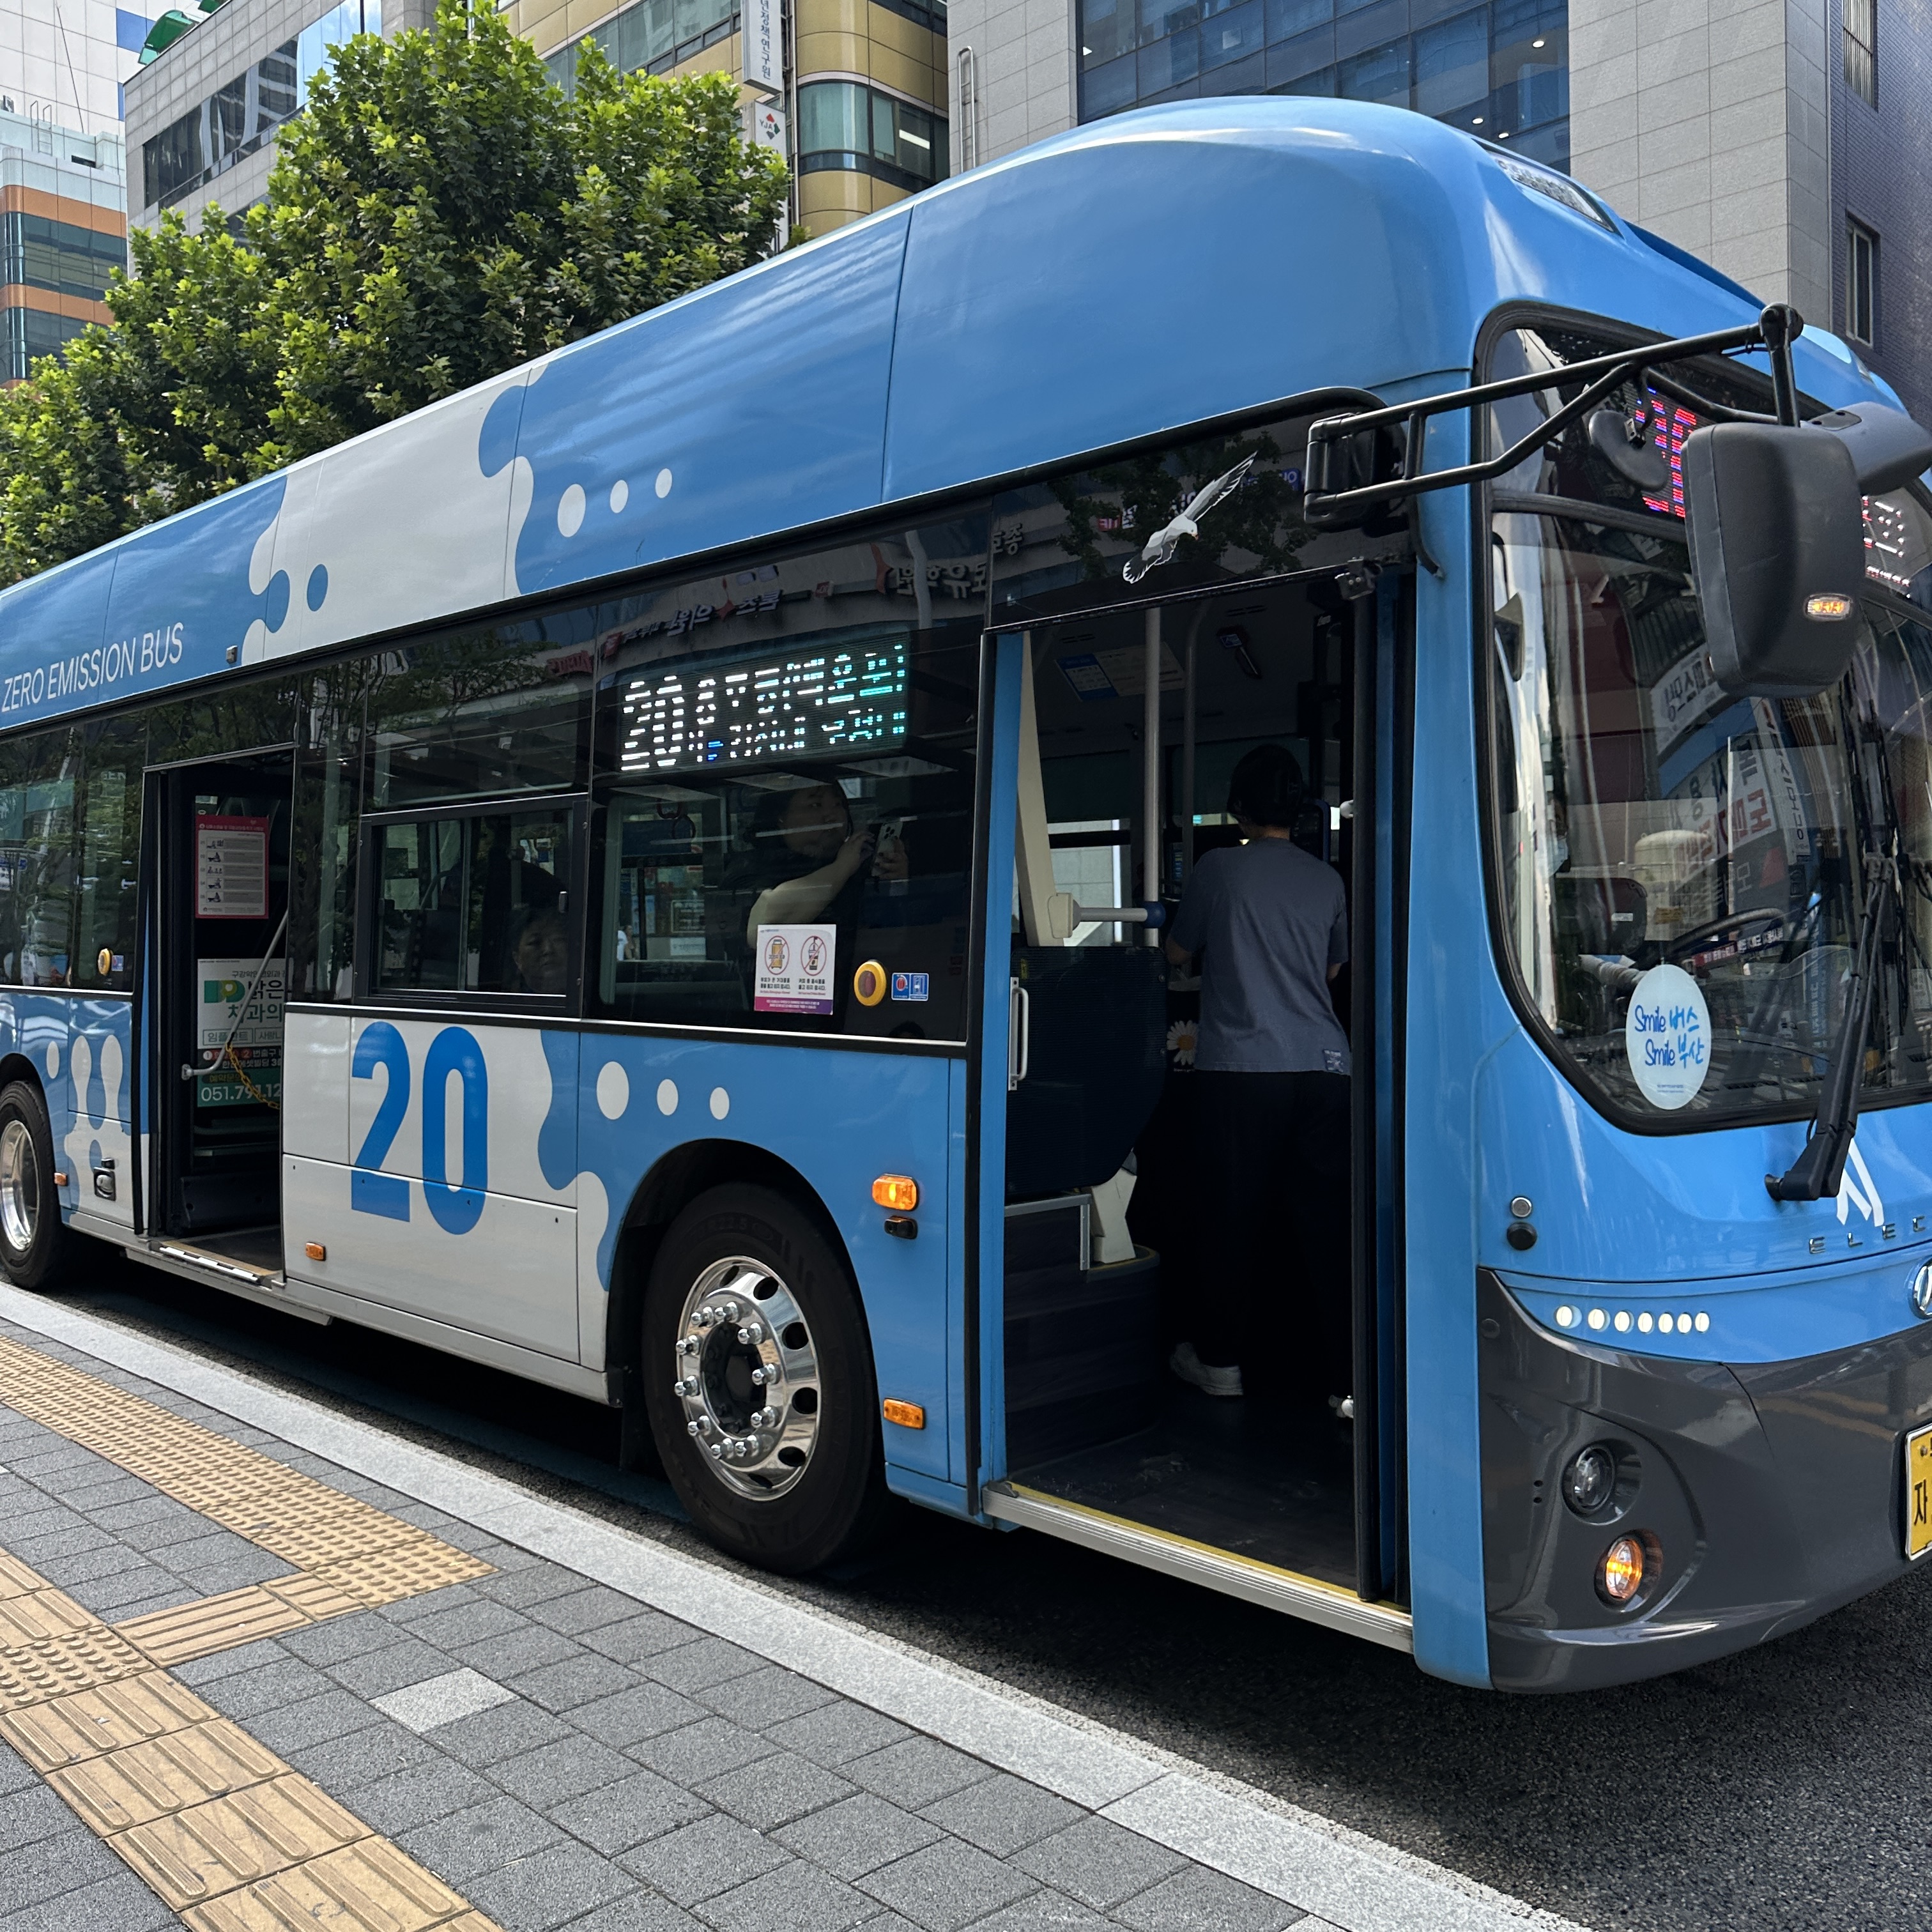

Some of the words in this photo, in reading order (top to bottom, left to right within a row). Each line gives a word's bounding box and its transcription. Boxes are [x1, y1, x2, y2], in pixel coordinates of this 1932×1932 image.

[759, 119, 772, 131] YJA
[2, 668, 44, 712] ZERO
[47, 638, 136, 700] EMISSION
[140, 622, 183, 673] BUS
[1634, 1004, 1666, 1032] Smile
[1669, 1005, 1699, 1032] 버스
[1644, 1038, 1675, 1066] Smile
[1677, 1032, 1705, 1069] 부산
[351, 1021, 488, 1235] 20
